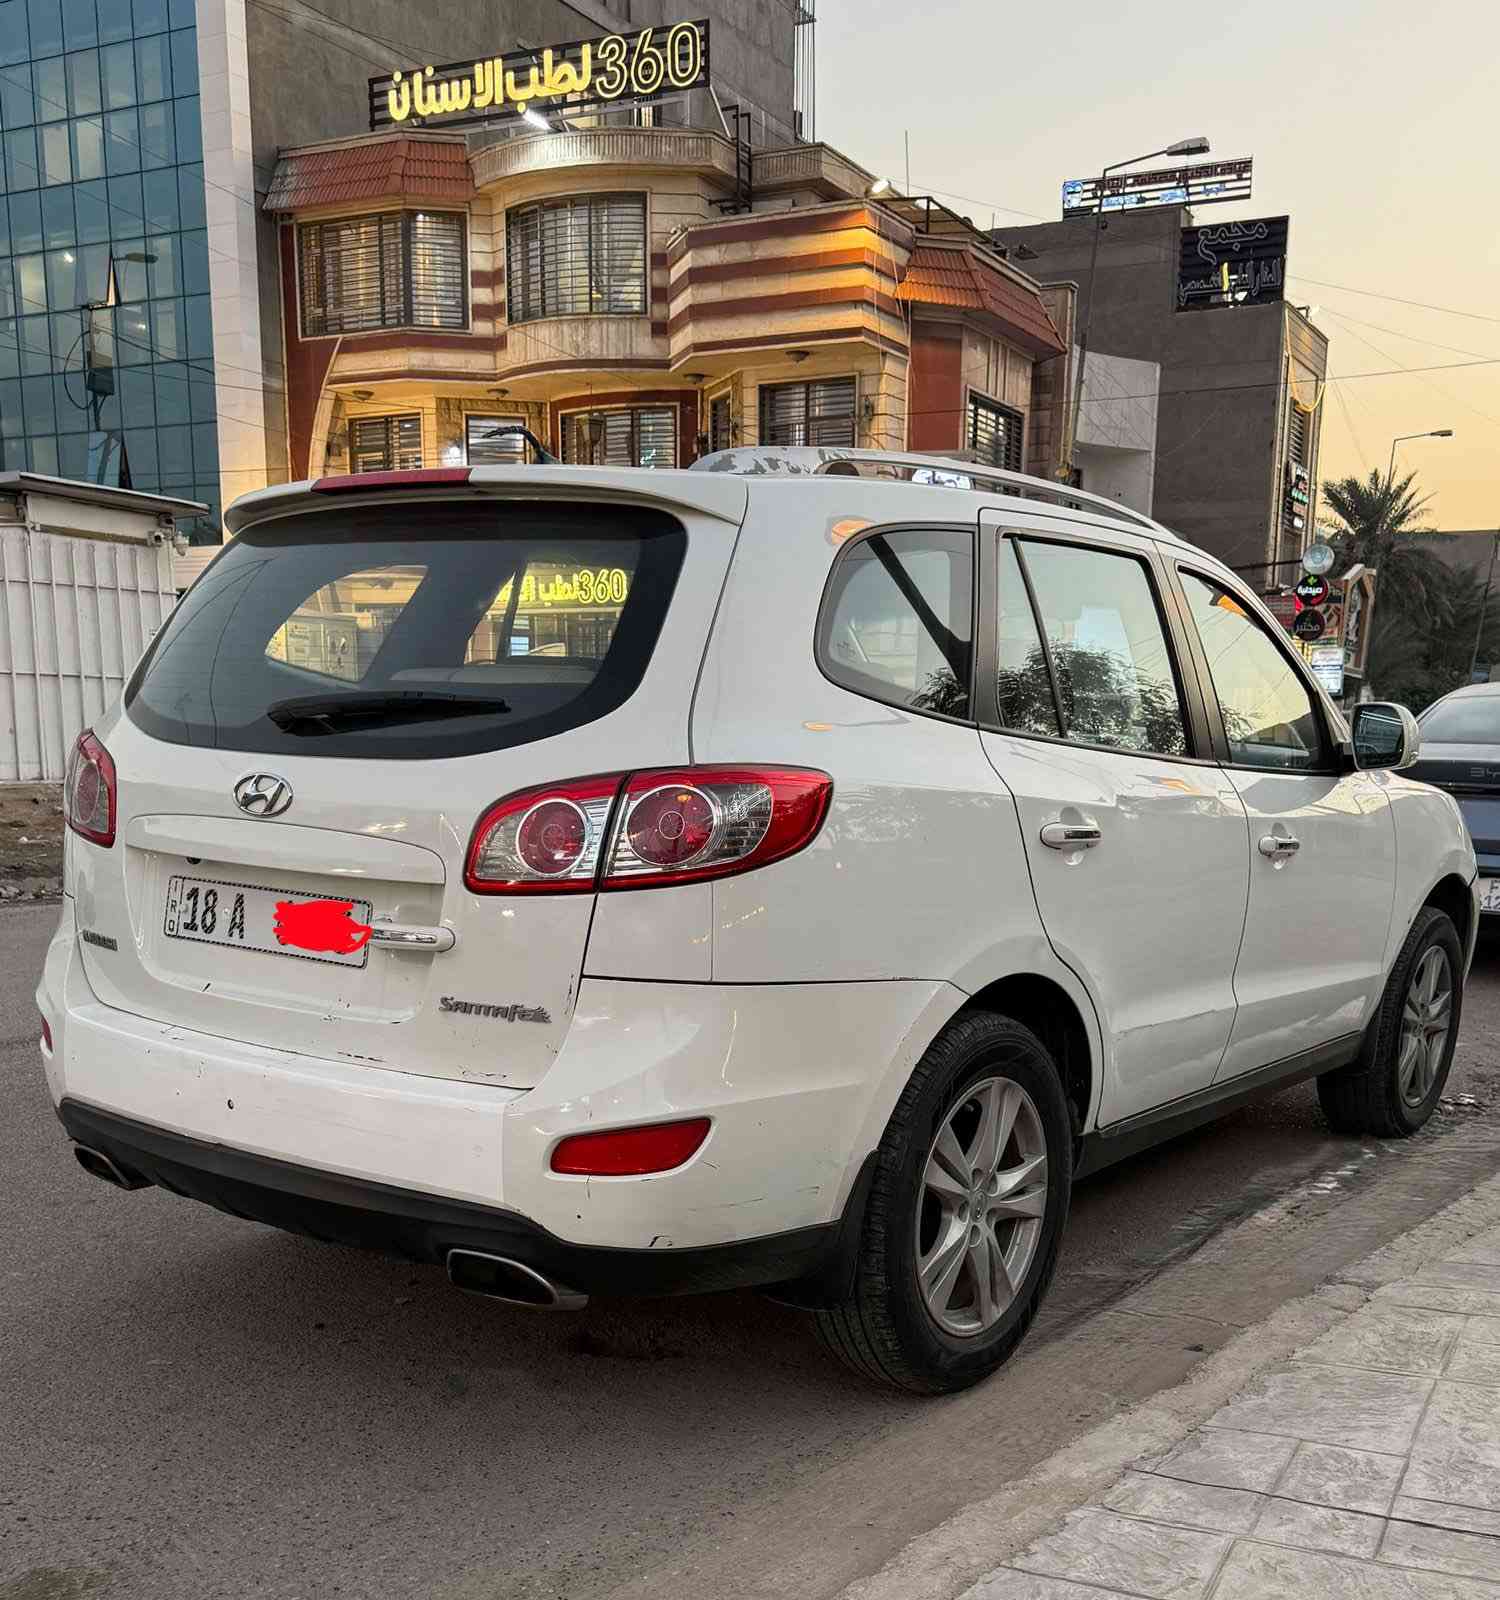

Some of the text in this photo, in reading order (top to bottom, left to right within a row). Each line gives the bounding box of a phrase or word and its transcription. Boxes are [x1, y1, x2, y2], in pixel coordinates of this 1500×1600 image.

[387, 22, 700, 121] 360 لطب الاسنان
[1197, 222, 1268, 266] مجمع
[578, 568, 628, 604] 360
[183, 886, 218, 935] 18
[228, 892, 245, 940] A
